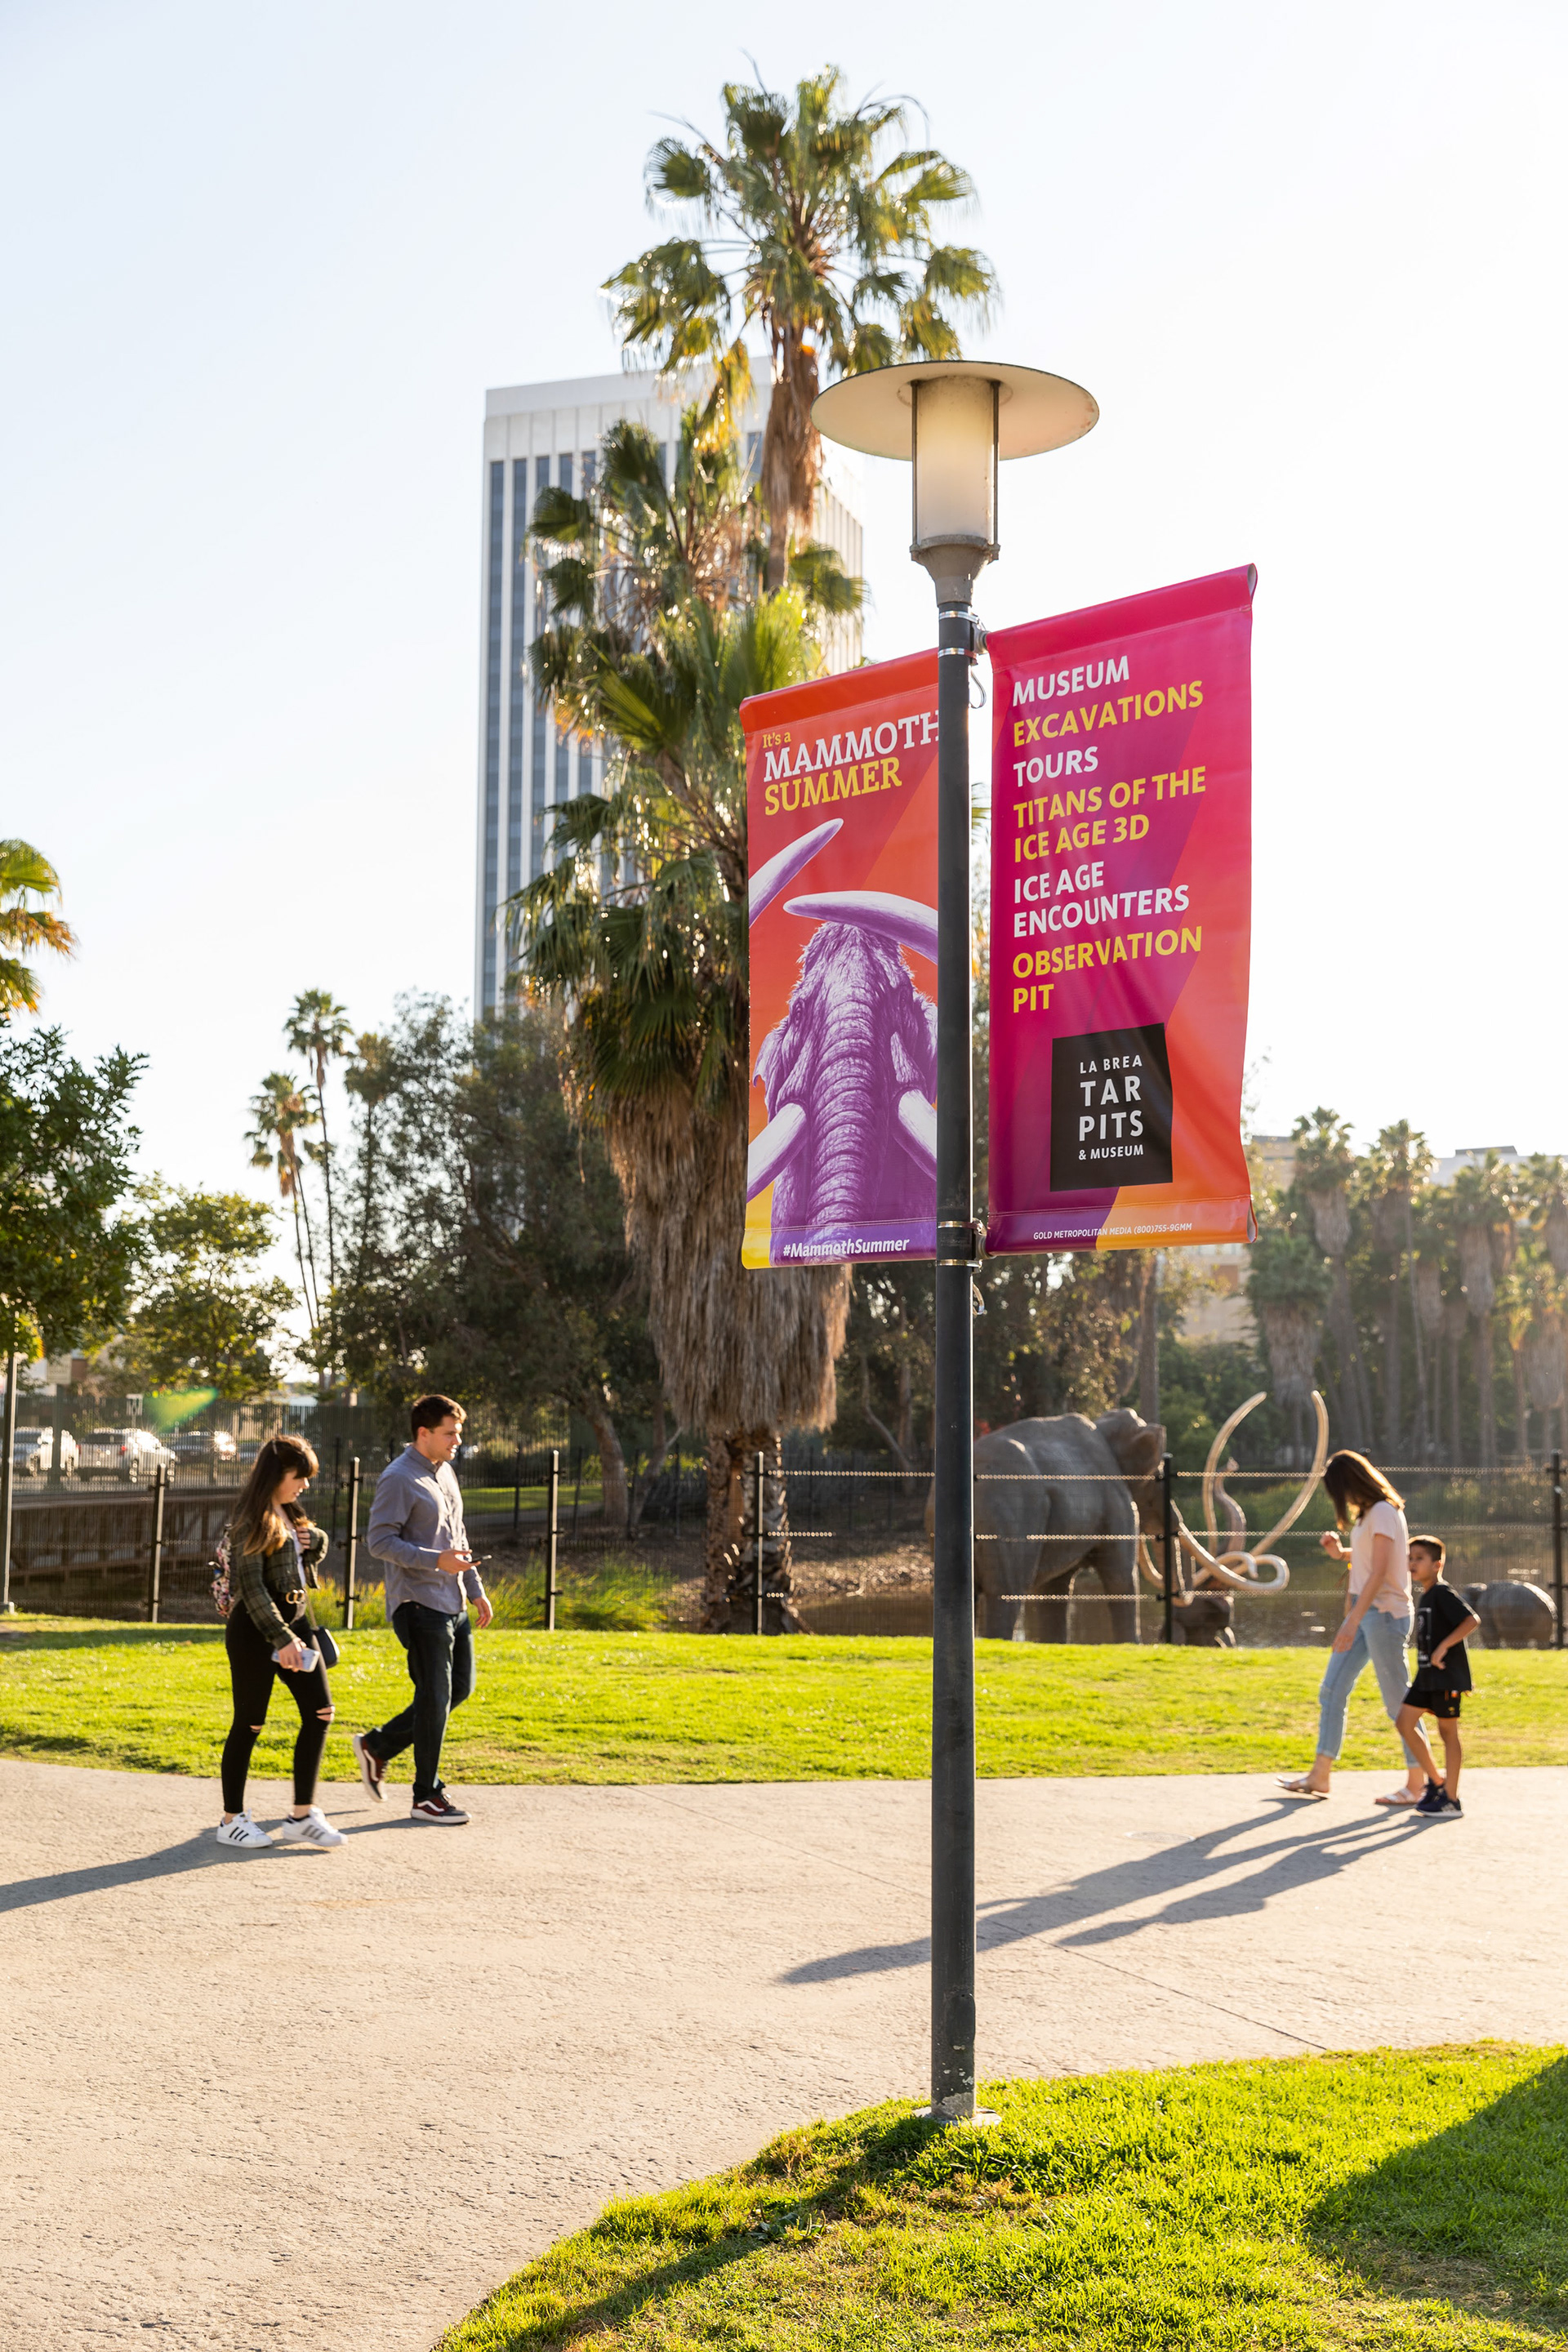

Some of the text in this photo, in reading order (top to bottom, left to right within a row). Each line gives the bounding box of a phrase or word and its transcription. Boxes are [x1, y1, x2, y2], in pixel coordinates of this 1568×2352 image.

[1013, 655, 1129, 706] MUSEUM
[1013, 680, 1204, 747] EXCAVATIONS
[763, 732, 791, 749] It's a
[764, 710, 939, 782] MAMMOTH
[764, 756, 902, 816] SUMMER
[1013, 746, 1098, 787] TOURS
[1013, 765, 1206, 828] TITANS OF THE
[1014, 814, 1149, 863] ICE AGE 3D
[1014, 861, 1104, 903] ICE AGE
[1013, 884, 1189, 938] ENCOUNTERS
[1013, 925, 1202, 978] OBSERVATION
[1013, 984, 1054, 1013] PIT
[1080, 1055, 1143, 1074] LA BREA
[1080, 1076, 1142, 1107] TAR
[1079, 1110, 1143, 1142] PITS
[1078, 1144, 1144, 1160] & MUSEUM
[783, 1238, 910, 1257] #MammothSummer
[1033, 1223, 1192, 1240] GOLD METROPOLITAN MEDIA (800)755-9GMM
